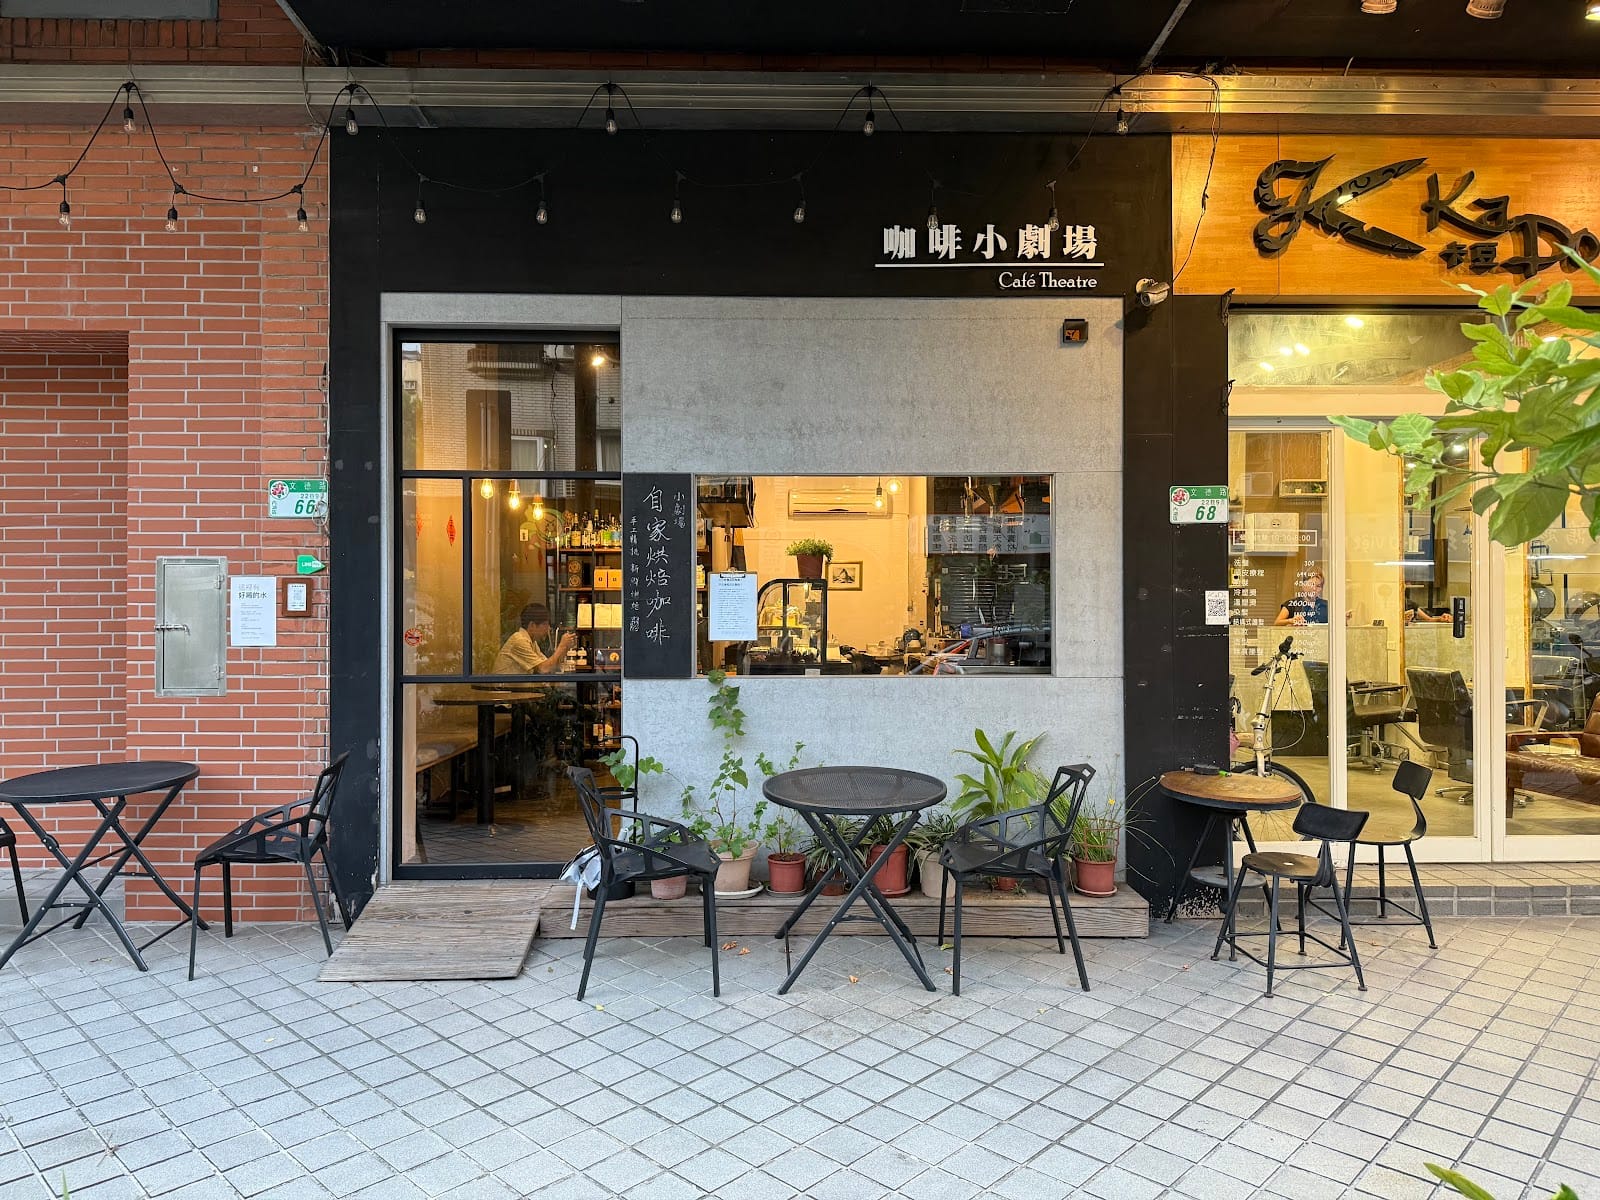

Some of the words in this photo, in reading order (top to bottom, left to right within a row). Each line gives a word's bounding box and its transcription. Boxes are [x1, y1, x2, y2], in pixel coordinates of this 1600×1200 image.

[883, 223, 1098, 260] 咖啡小劇場
[998, 271, 1036, 289] Café
[1038, 271, 1098, 289] Theatre
[1190, 487, 1227, 496] 文德路
[294, 499, 316, 515] 66
[673, 491, 686, 529] 小劇場
[1195, 505, 1217, 521] 68
[642, 485, 672, 646] 自家烘焙咖啡
